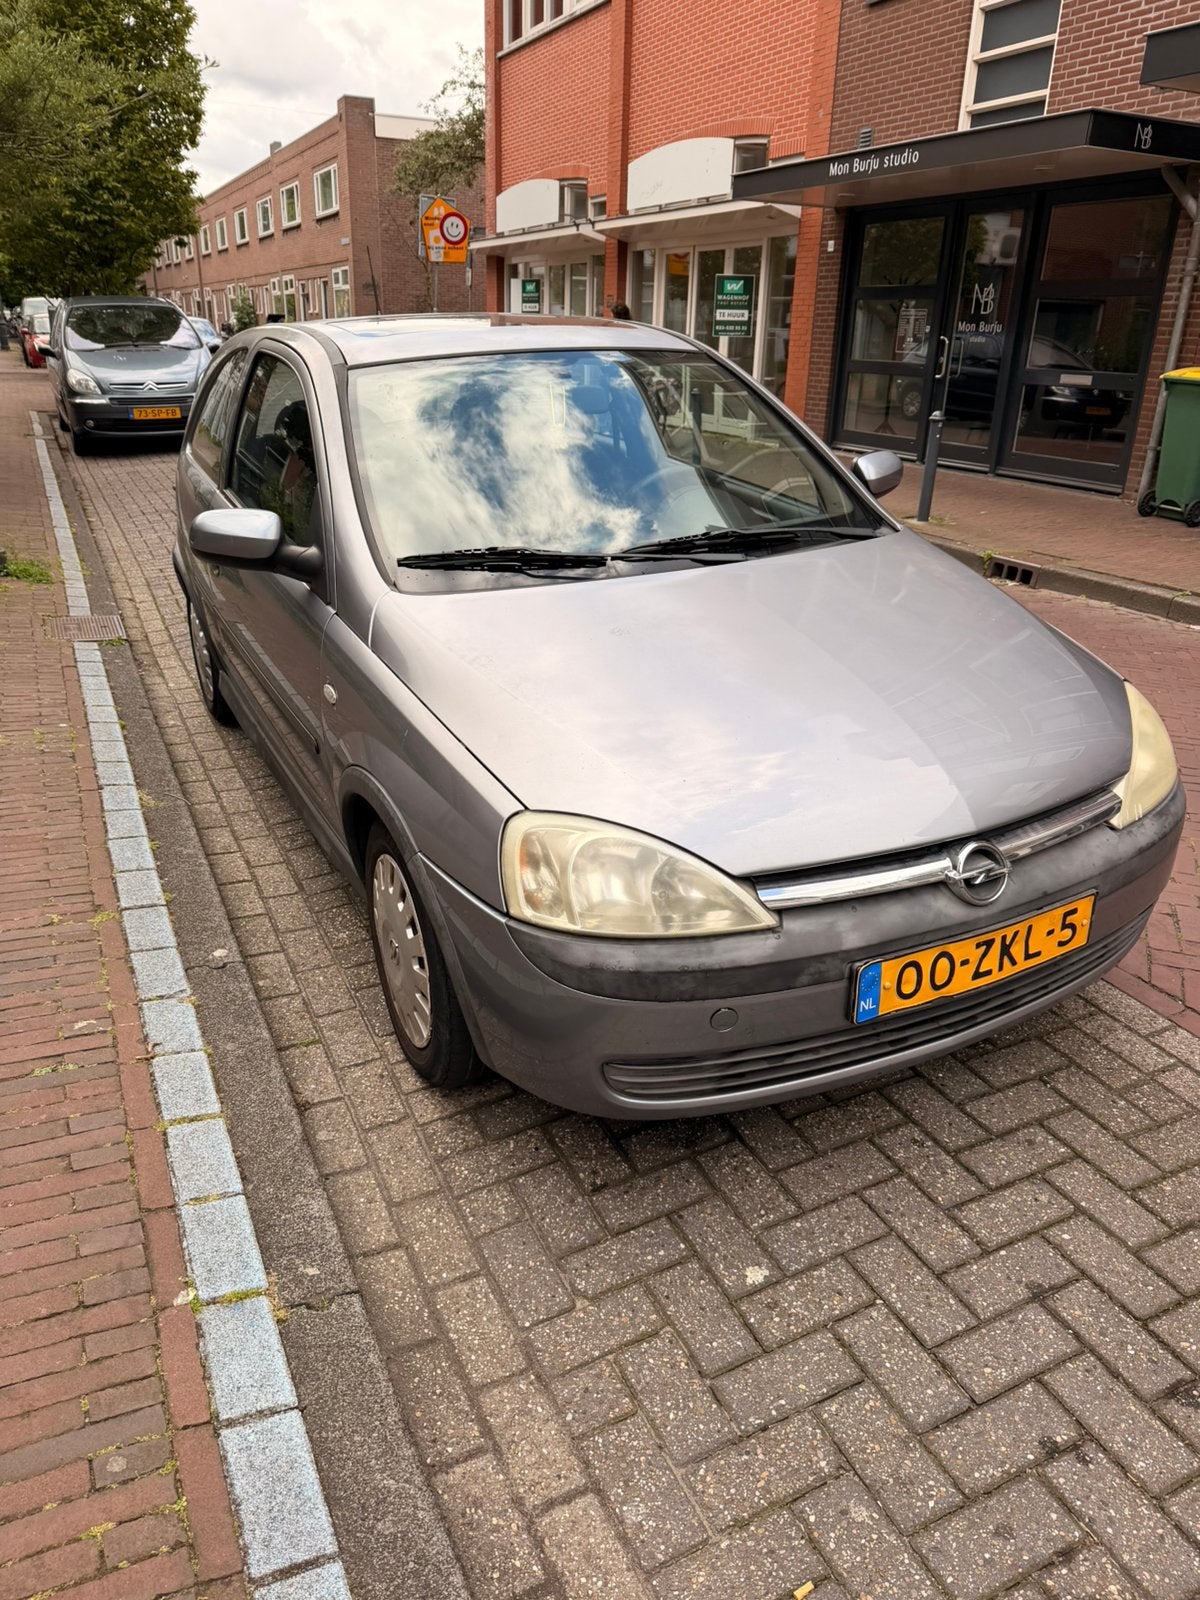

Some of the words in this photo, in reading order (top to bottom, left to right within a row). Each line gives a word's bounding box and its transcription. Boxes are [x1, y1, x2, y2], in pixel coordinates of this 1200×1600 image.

[829, 161, 849, 177] Mon
[883, 148, 919, 168] studio
[958, 321, 976, 332] Mon
[137, 409, 177, 418] 73-SP-FB
[896, 908, 1079, 1001] 00-ZKL-5
[859, 997, 877, 1012] NL
